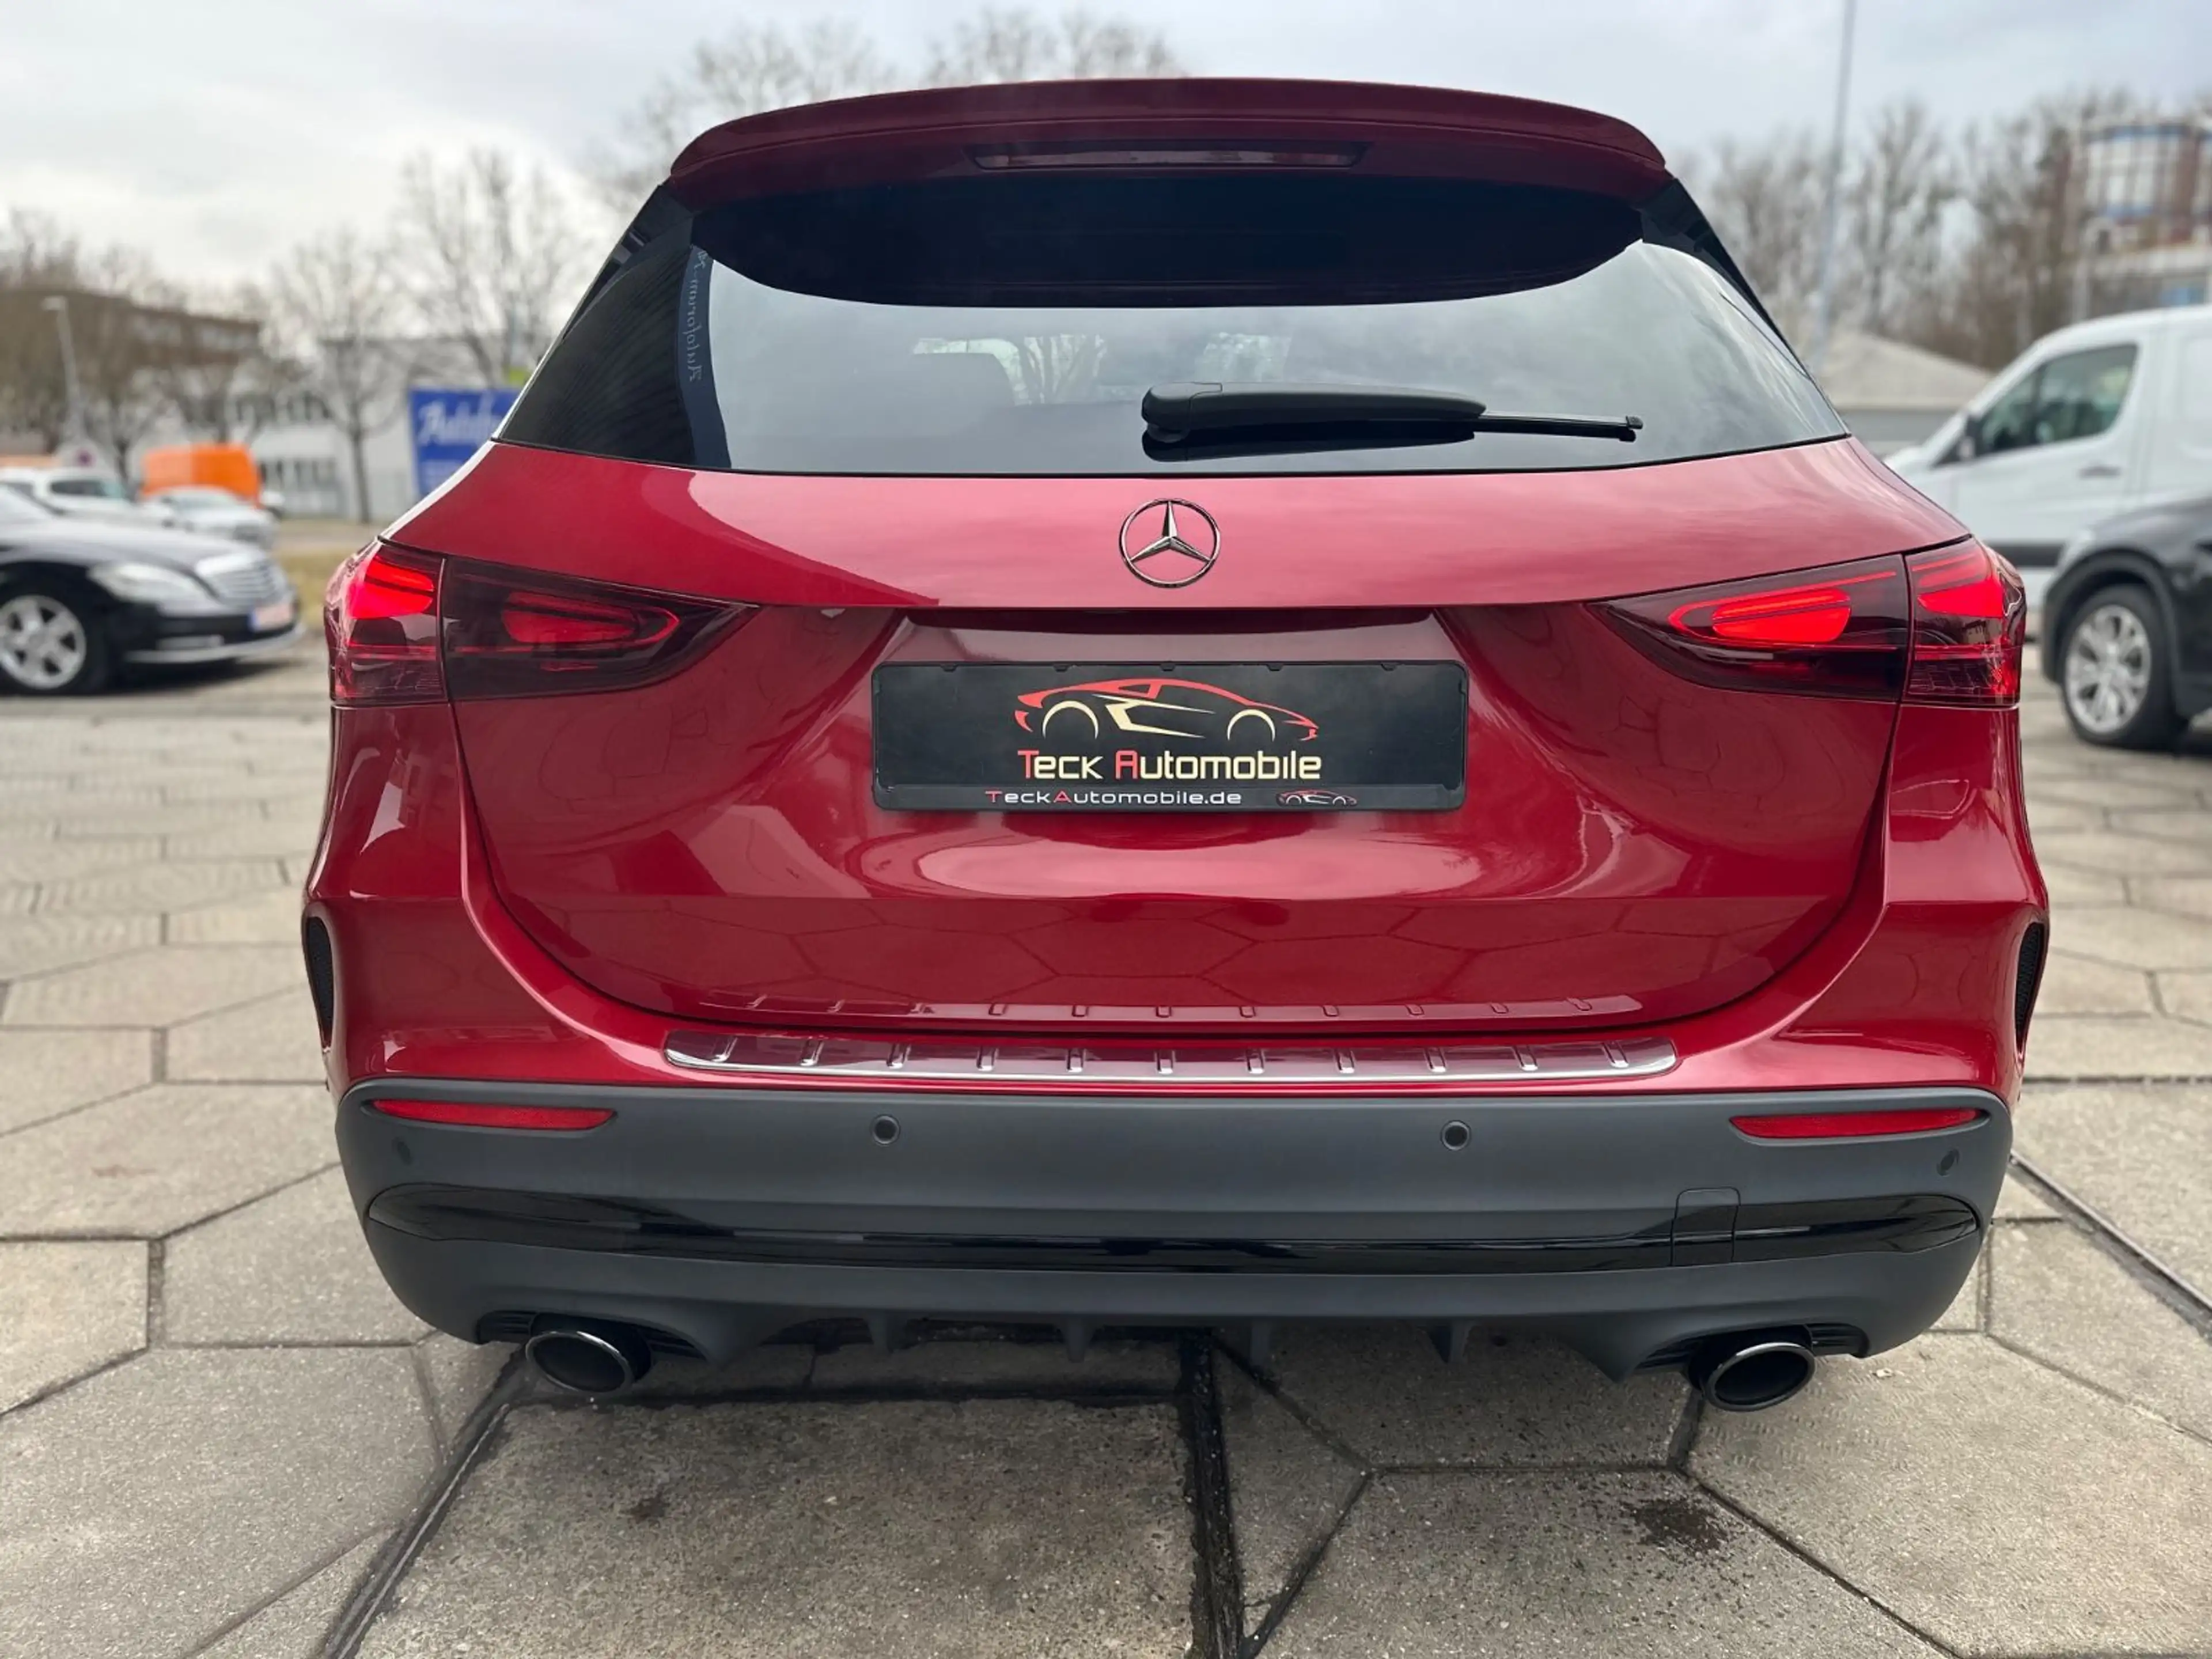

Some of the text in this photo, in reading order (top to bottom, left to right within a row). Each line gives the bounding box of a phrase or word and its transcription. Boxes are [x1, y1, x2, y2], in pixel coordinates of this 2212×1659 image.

[1017, 750, 1321, 779] Teck Automobile
[985, 790, 1242, 804] TeckAutomobile.de
